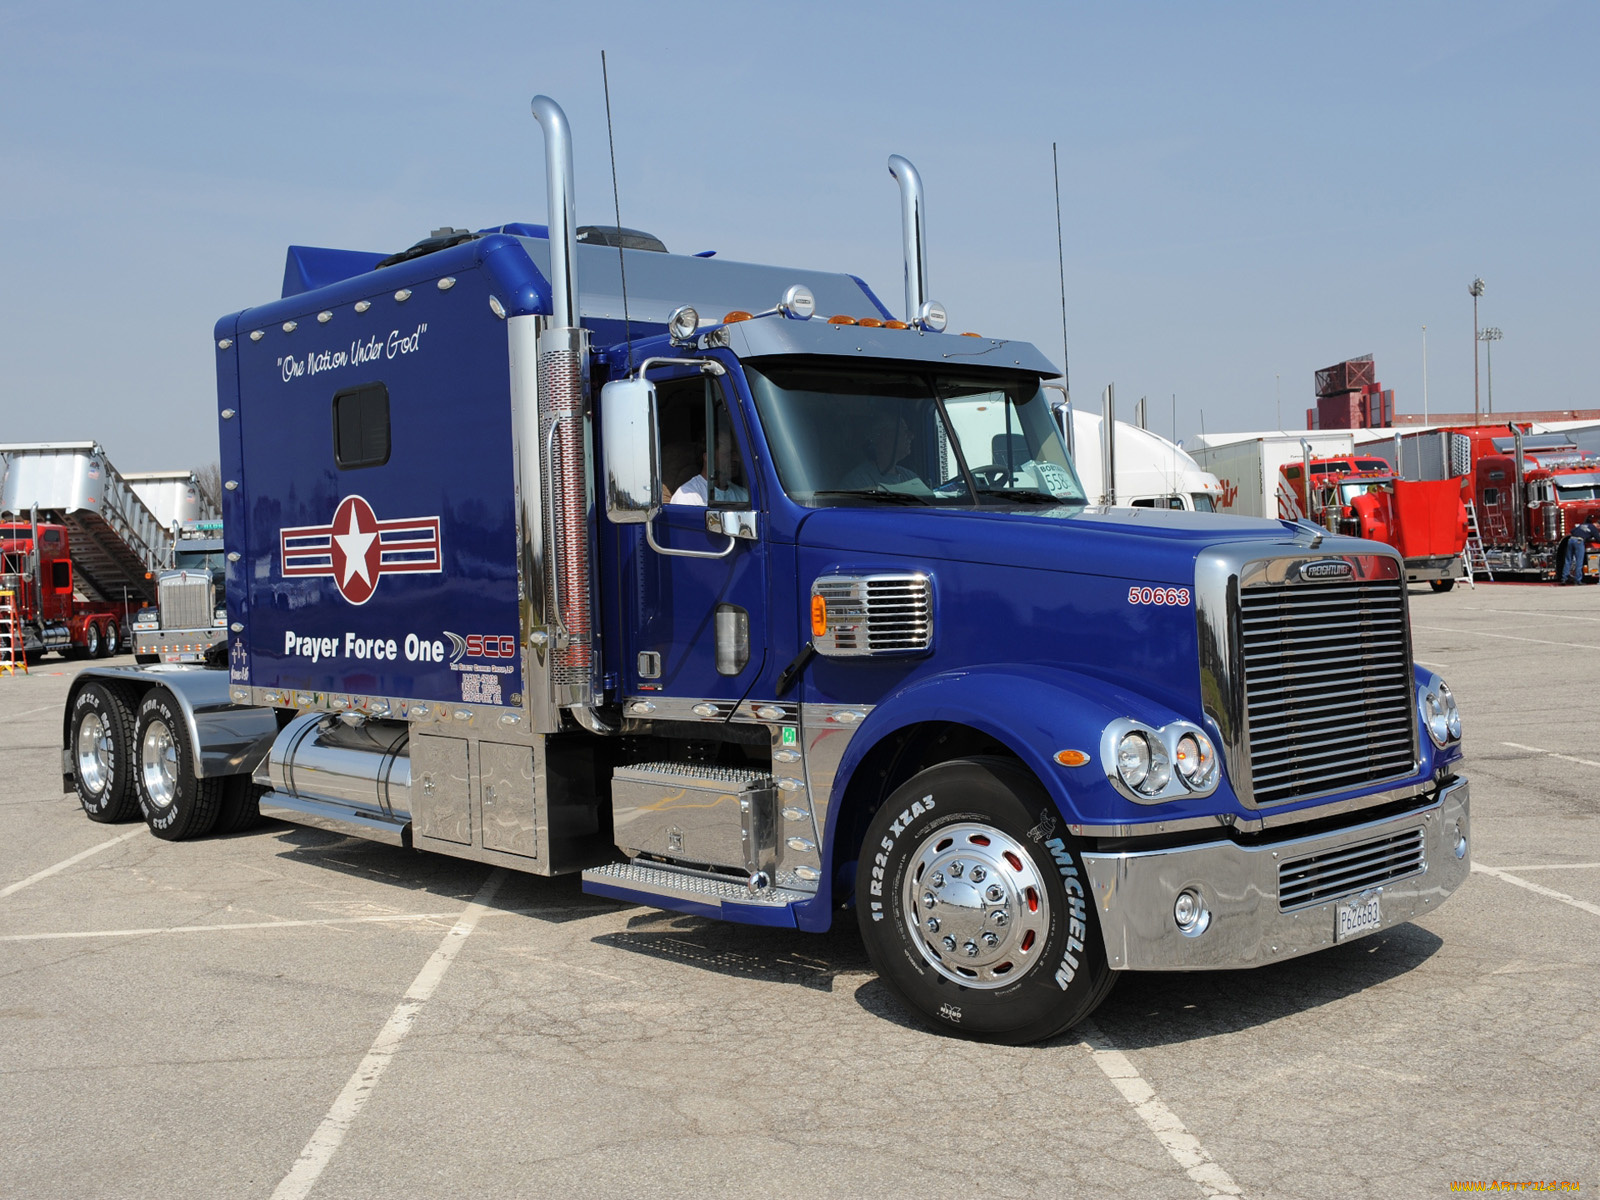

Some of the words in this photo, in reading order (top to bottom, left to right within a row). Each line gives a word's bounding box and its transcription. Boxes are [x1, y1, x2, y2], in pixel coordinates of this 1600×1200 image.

[307, 350, 348, 376] Nation
[351, 335, 384, 367] Under
[1127, 587, 1190, 606] 50663
[285, 631, 339, 663] Prayer
[345, 632, 397, 660] Force
[404, 633, 444, 662] One
[466, 634, 515, 658] SCG
[101, 712, 114, 809] MICHELIN
[889, 794, 936, 839] XZA3
[1045, 837, 1087, 991] MICHELIN
[1342, 902, 1377, 932] P626683
